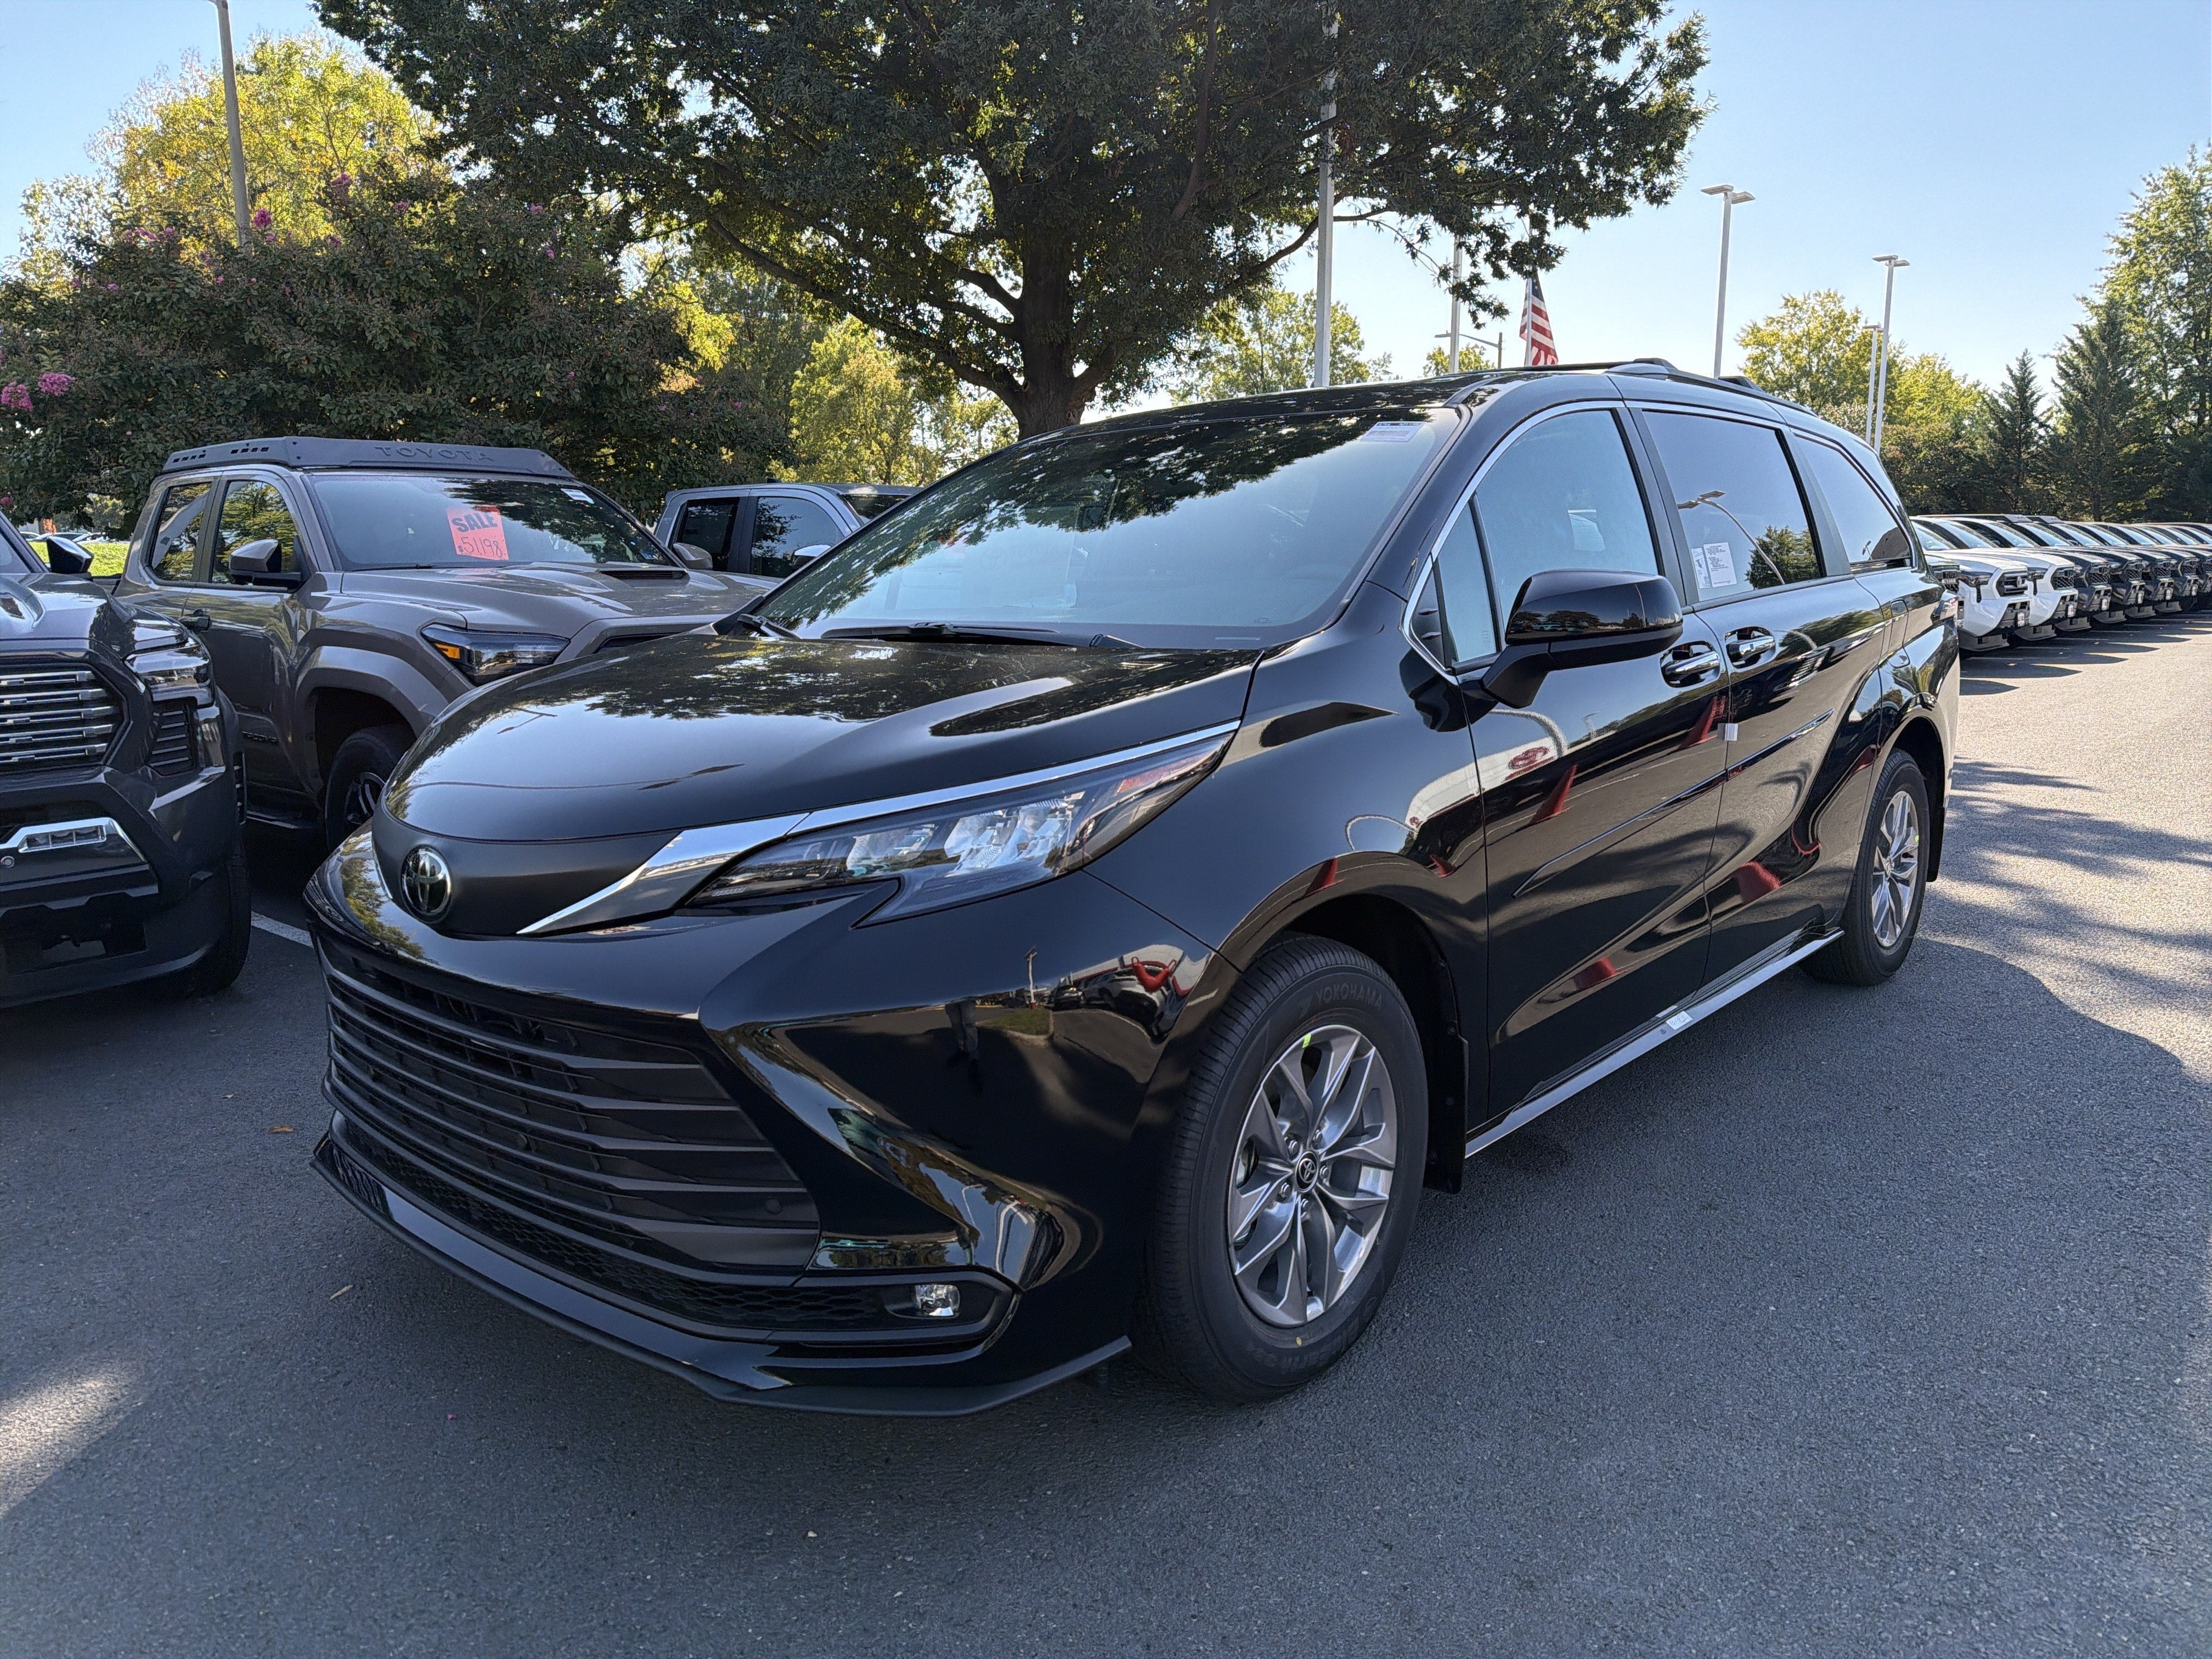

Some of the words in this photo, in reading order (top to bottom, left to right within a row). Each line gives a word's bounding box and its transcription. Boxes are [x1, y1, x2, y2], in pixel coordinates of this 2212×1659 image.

[374, 446, 494, 461] TOYOTA
[452, 513, 498, 533] SALE
[1316, 983, 1382, 1011] YOKOHAMA
